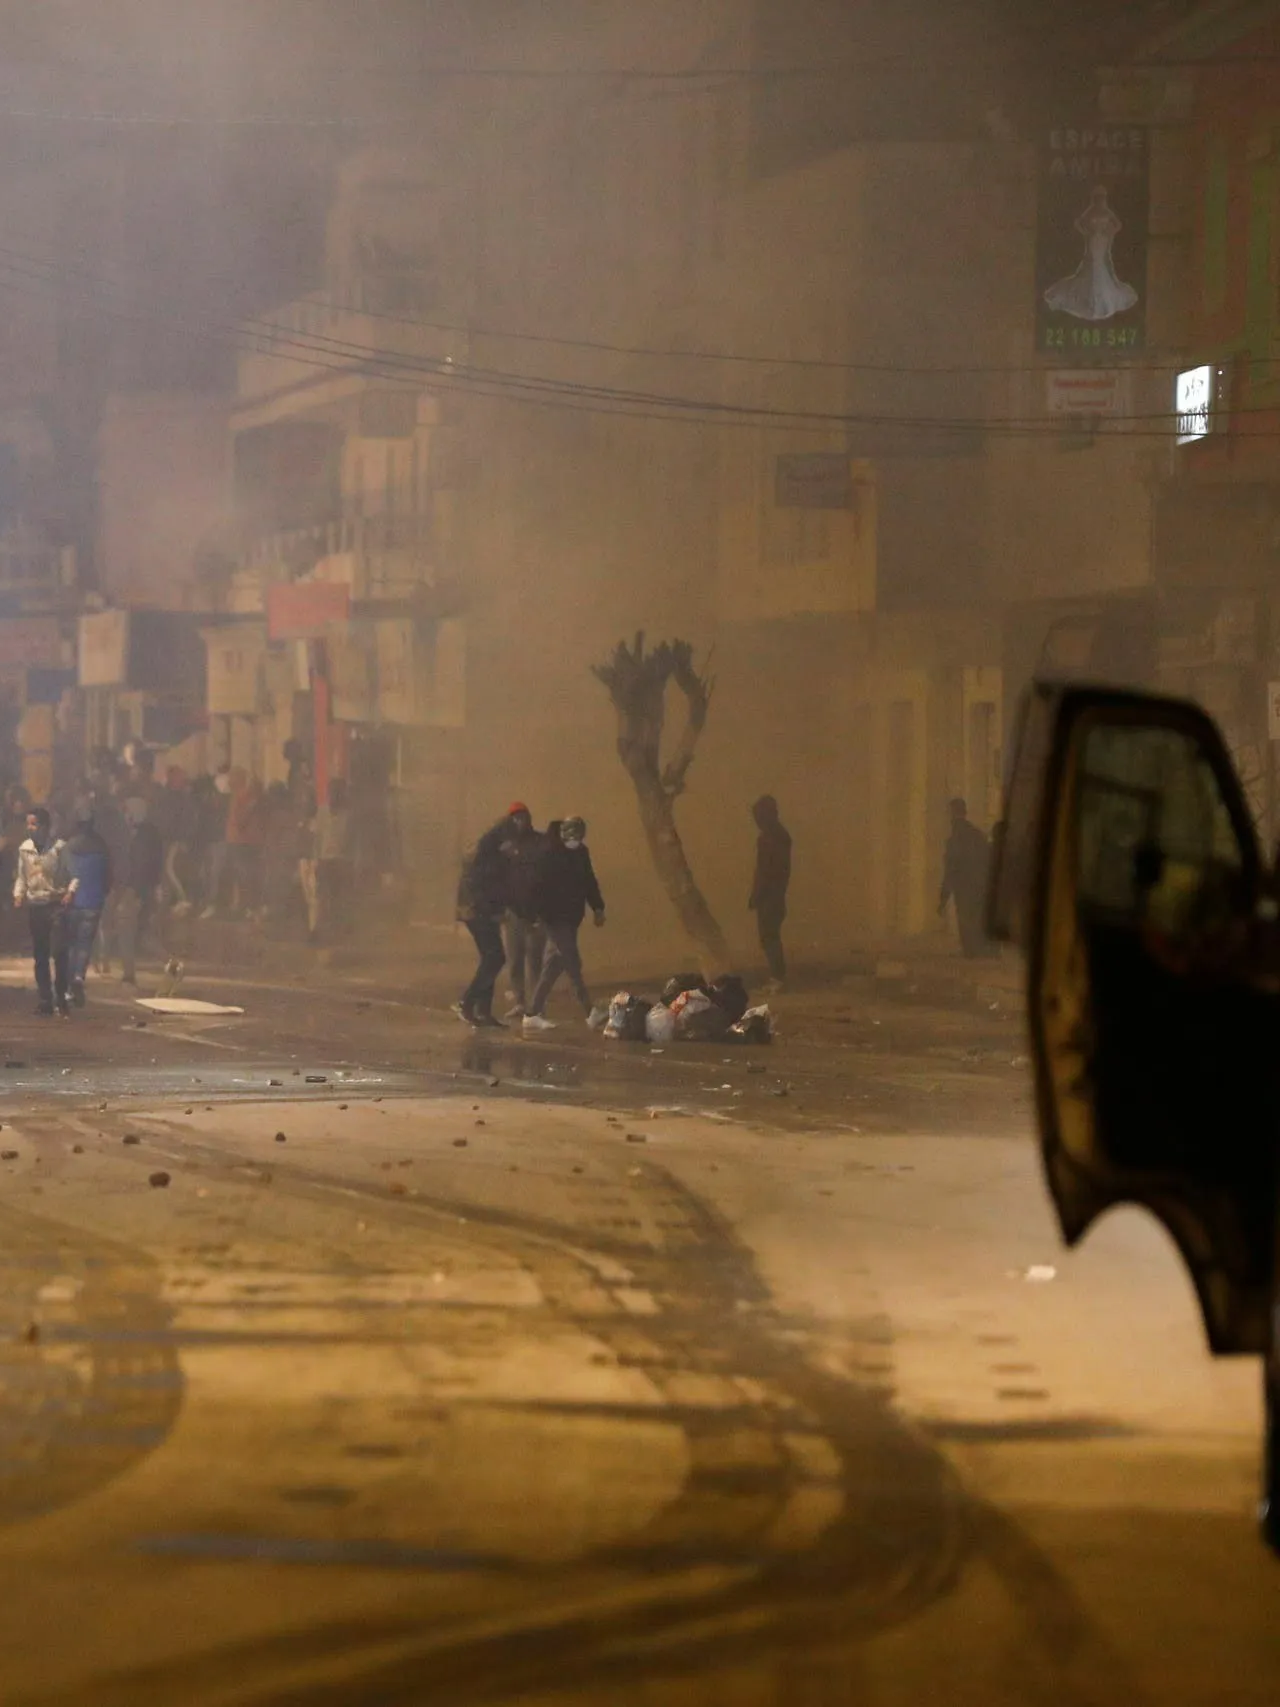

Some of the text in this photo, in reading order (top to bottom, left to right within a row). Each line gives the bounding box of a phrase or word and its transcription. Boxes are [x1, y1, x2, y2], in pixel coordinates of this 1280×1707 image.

[1049, 129, 1144, 150] ESPACE
[1045, 327, 1065, 346] 22
[1106, 327, 1137, 346] 547
